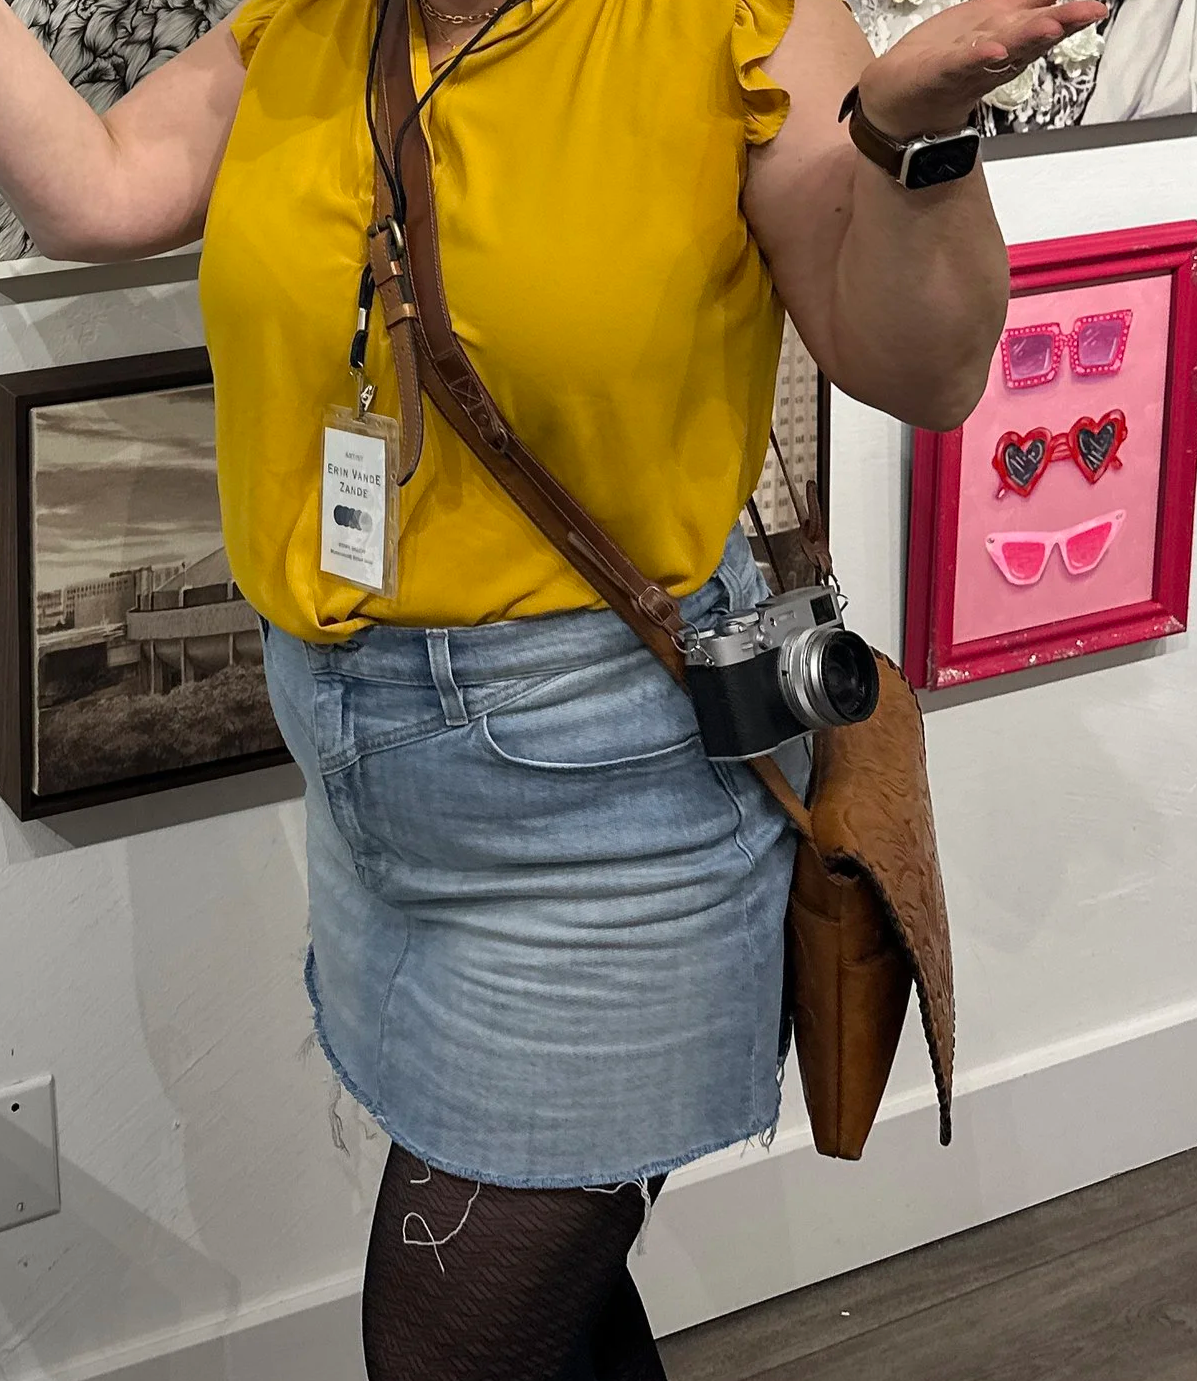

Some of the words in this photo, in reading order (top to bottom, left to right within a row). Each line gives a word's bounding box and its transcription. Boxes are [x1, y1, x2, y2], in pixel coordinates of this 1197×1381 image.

[327, 463, 349, 479] ERIN
[352, 470, 381, 487] VANDE
[339, 481, 369, 499] ZANDE
